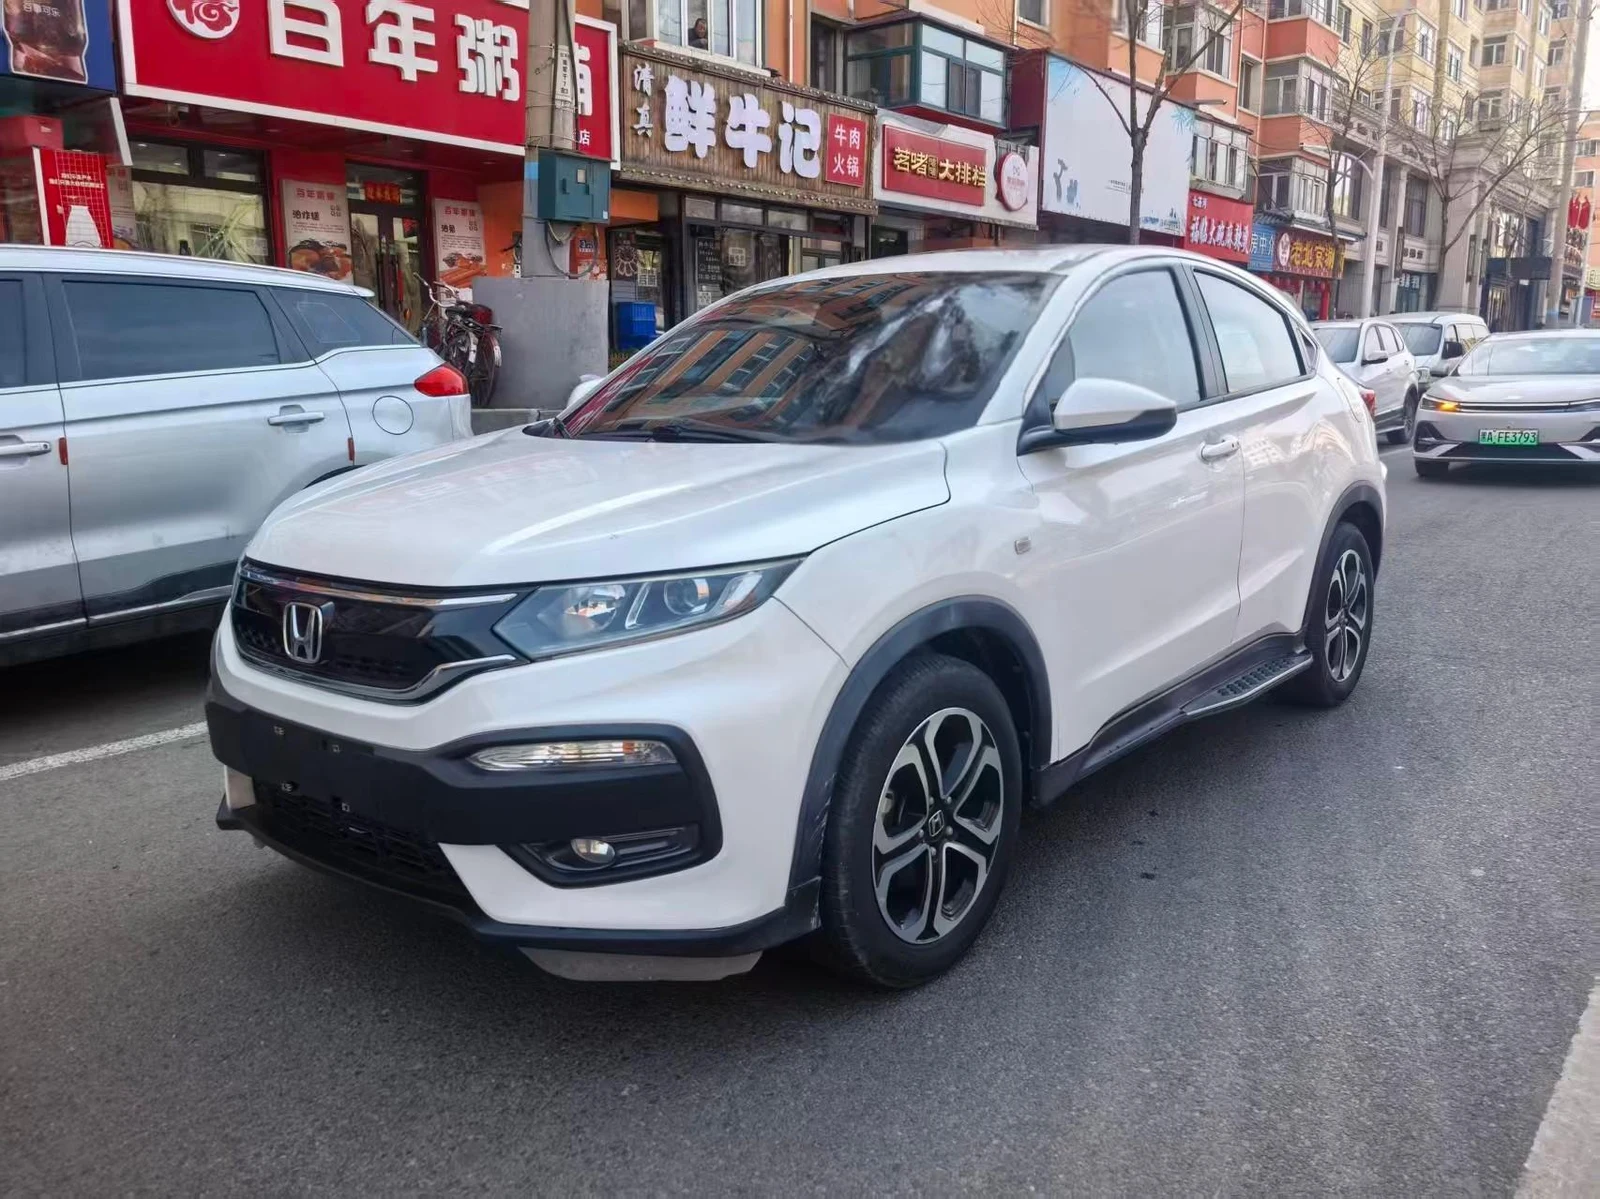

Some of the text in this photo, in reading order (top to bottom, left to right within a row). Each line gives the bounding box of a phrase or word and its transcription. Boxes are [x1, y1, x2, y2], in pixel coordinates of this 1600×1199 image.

[268, 0, 592, 117] 百年粥
[633, 62, 654, 138] 清真
[664, 75, 822, 179] 鲜牛记
[834, 123, 861, 151] 牛肉
[832, 153, 860, 178] 火锅
